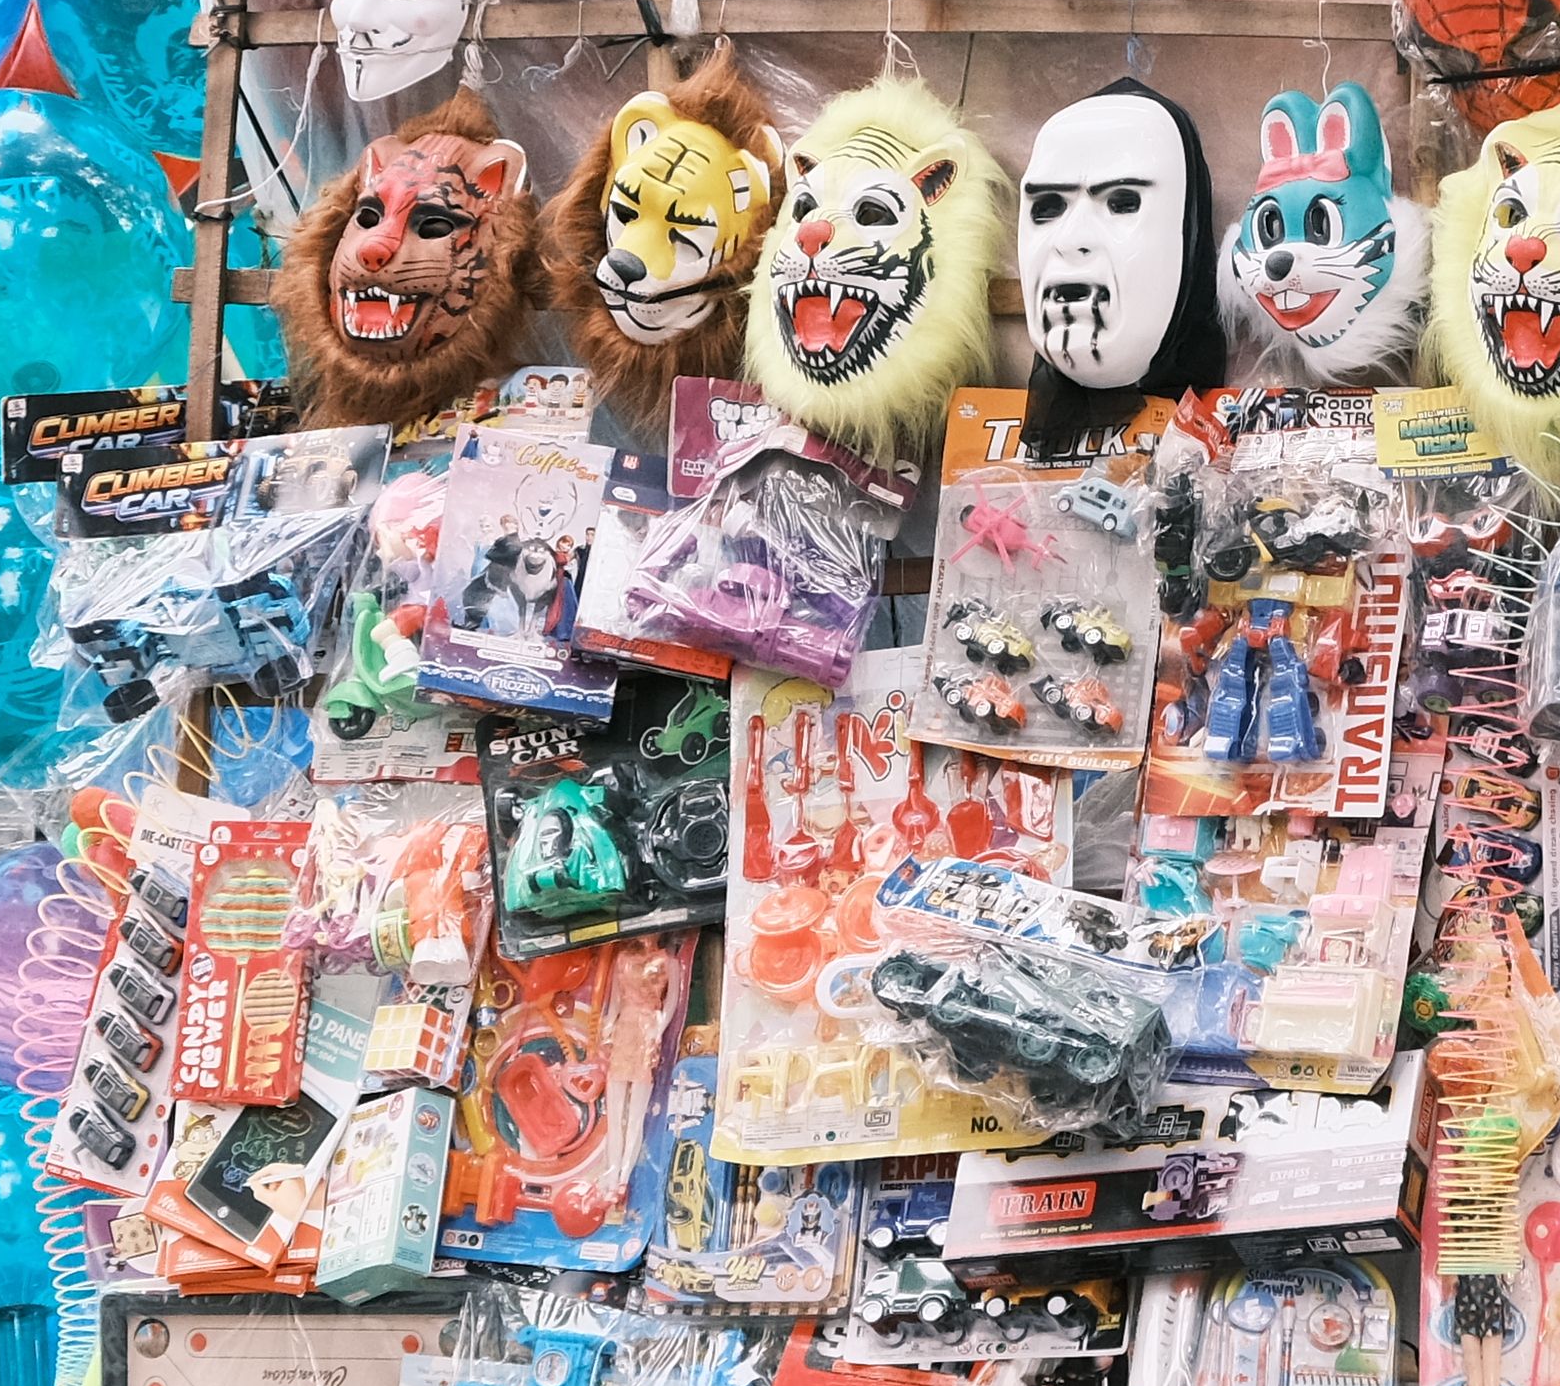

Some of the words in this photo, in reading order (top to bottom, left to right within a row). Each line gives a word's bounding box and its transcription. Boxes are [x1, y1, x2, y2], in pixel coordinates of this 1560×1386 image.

[30, 402, 184, 446] CLIMBER
[1399, 416, 1475, 439] MONSTER
[515, 443, 578, 474] Coffee
[85, 456, 231, 502] CLIMBER
[119, 488, 193, 515] CAR
[490, 675, 542, 696] FROZEN
[489, 726, 588, 756] STUNT
[511, 740, 581, 764] CAR
[1029, 753, 1065, 764] CITY
[1066, 756, 1132, 770] BUILDER
[1548, 788, 1558, 824] chasing
[140, 829, 183, 851] DIE-CAST
[179, 983, 207, 1084] CANDY
[199, 980, 229, 1088] FLOWER
[971, 1116, 1003, 1133] NO.
[998, 1189, 1087, 1215] TRAIN
[1247, 1268, 1305, 1288] Stationery
